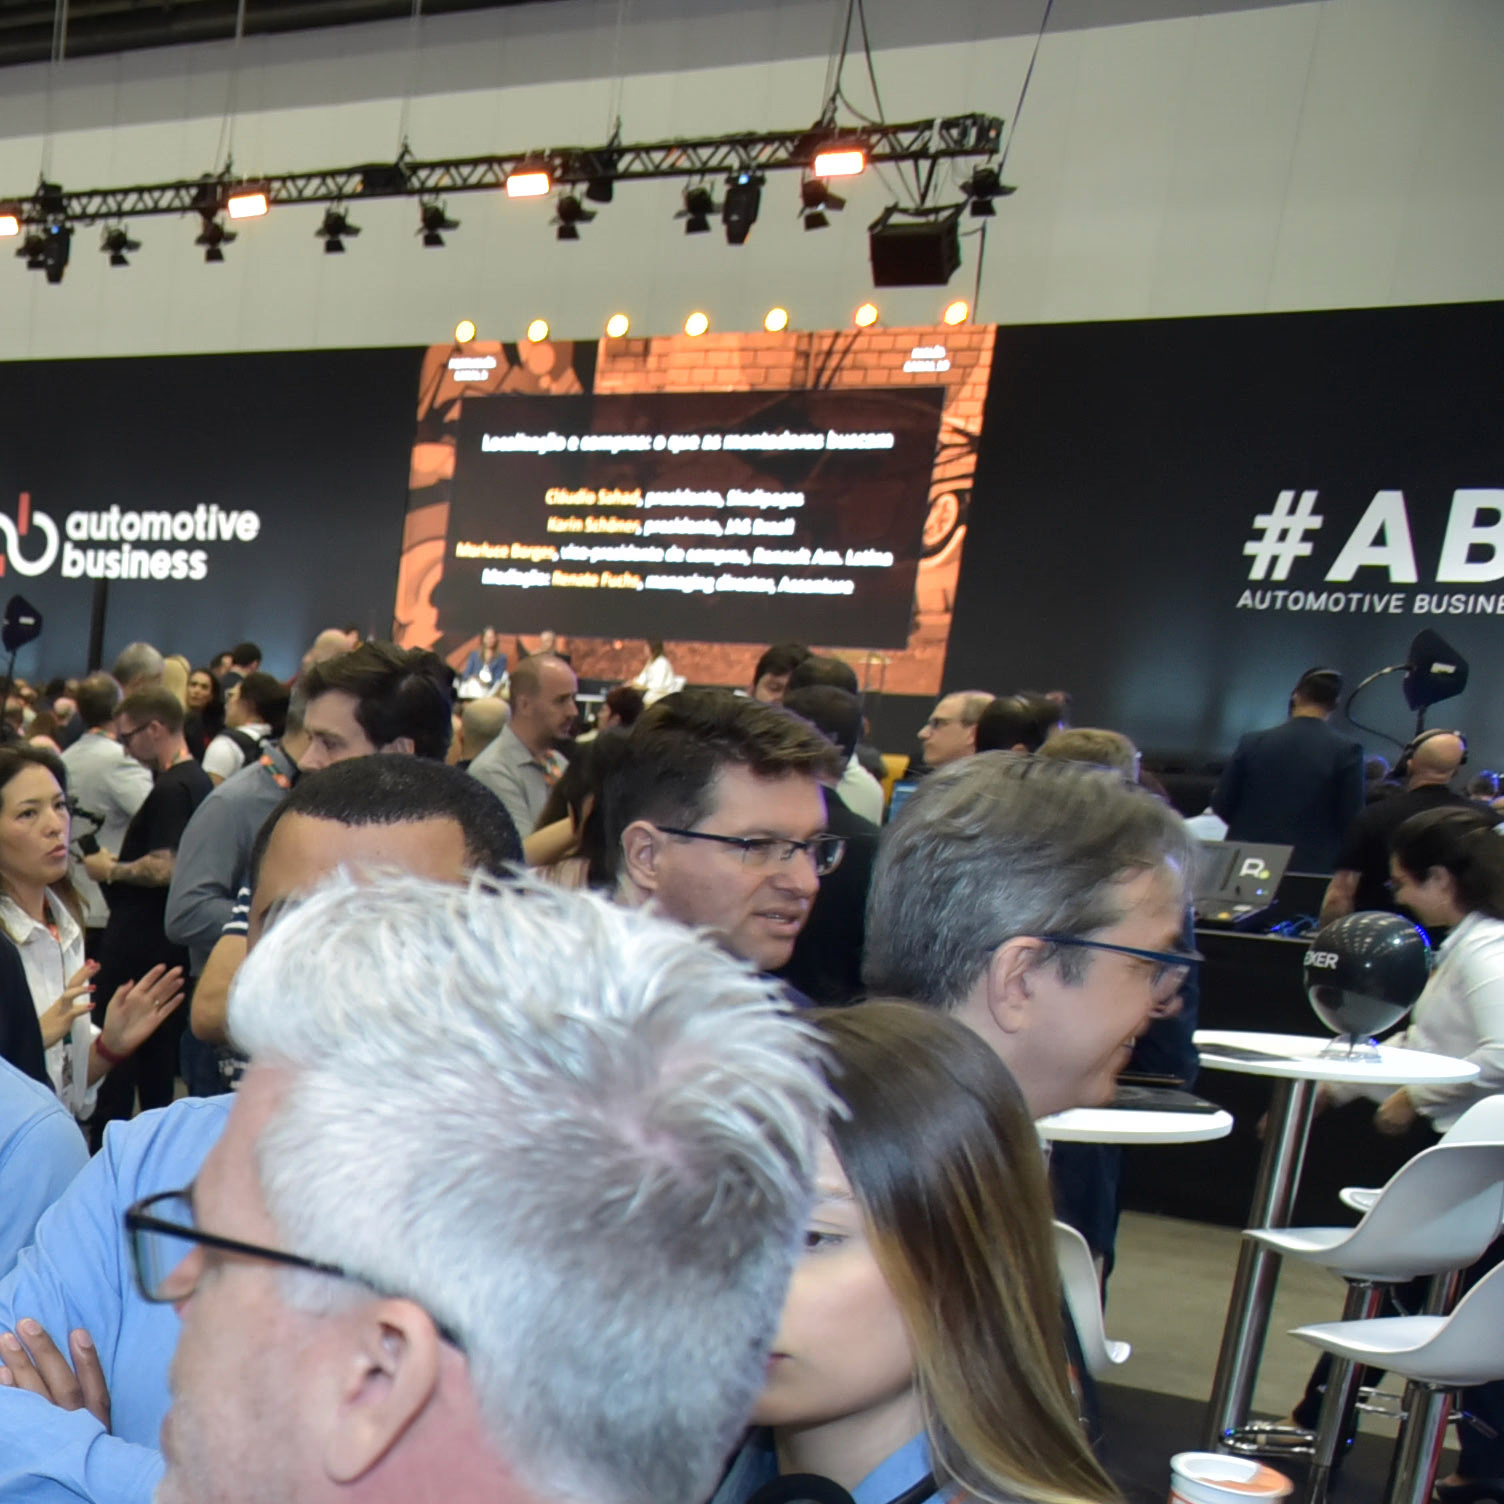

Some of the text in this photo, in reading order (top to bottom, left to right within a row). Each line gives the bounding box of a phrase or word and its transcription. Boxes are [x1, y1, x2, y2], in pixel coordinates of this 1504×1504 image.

[65, 504, 260, 541] automotive
[1242, 488, 1504, 583] #AB
[61, 541, 208, 580] business
[1236, 588, 1406, 613] AUTOMOTIVE
